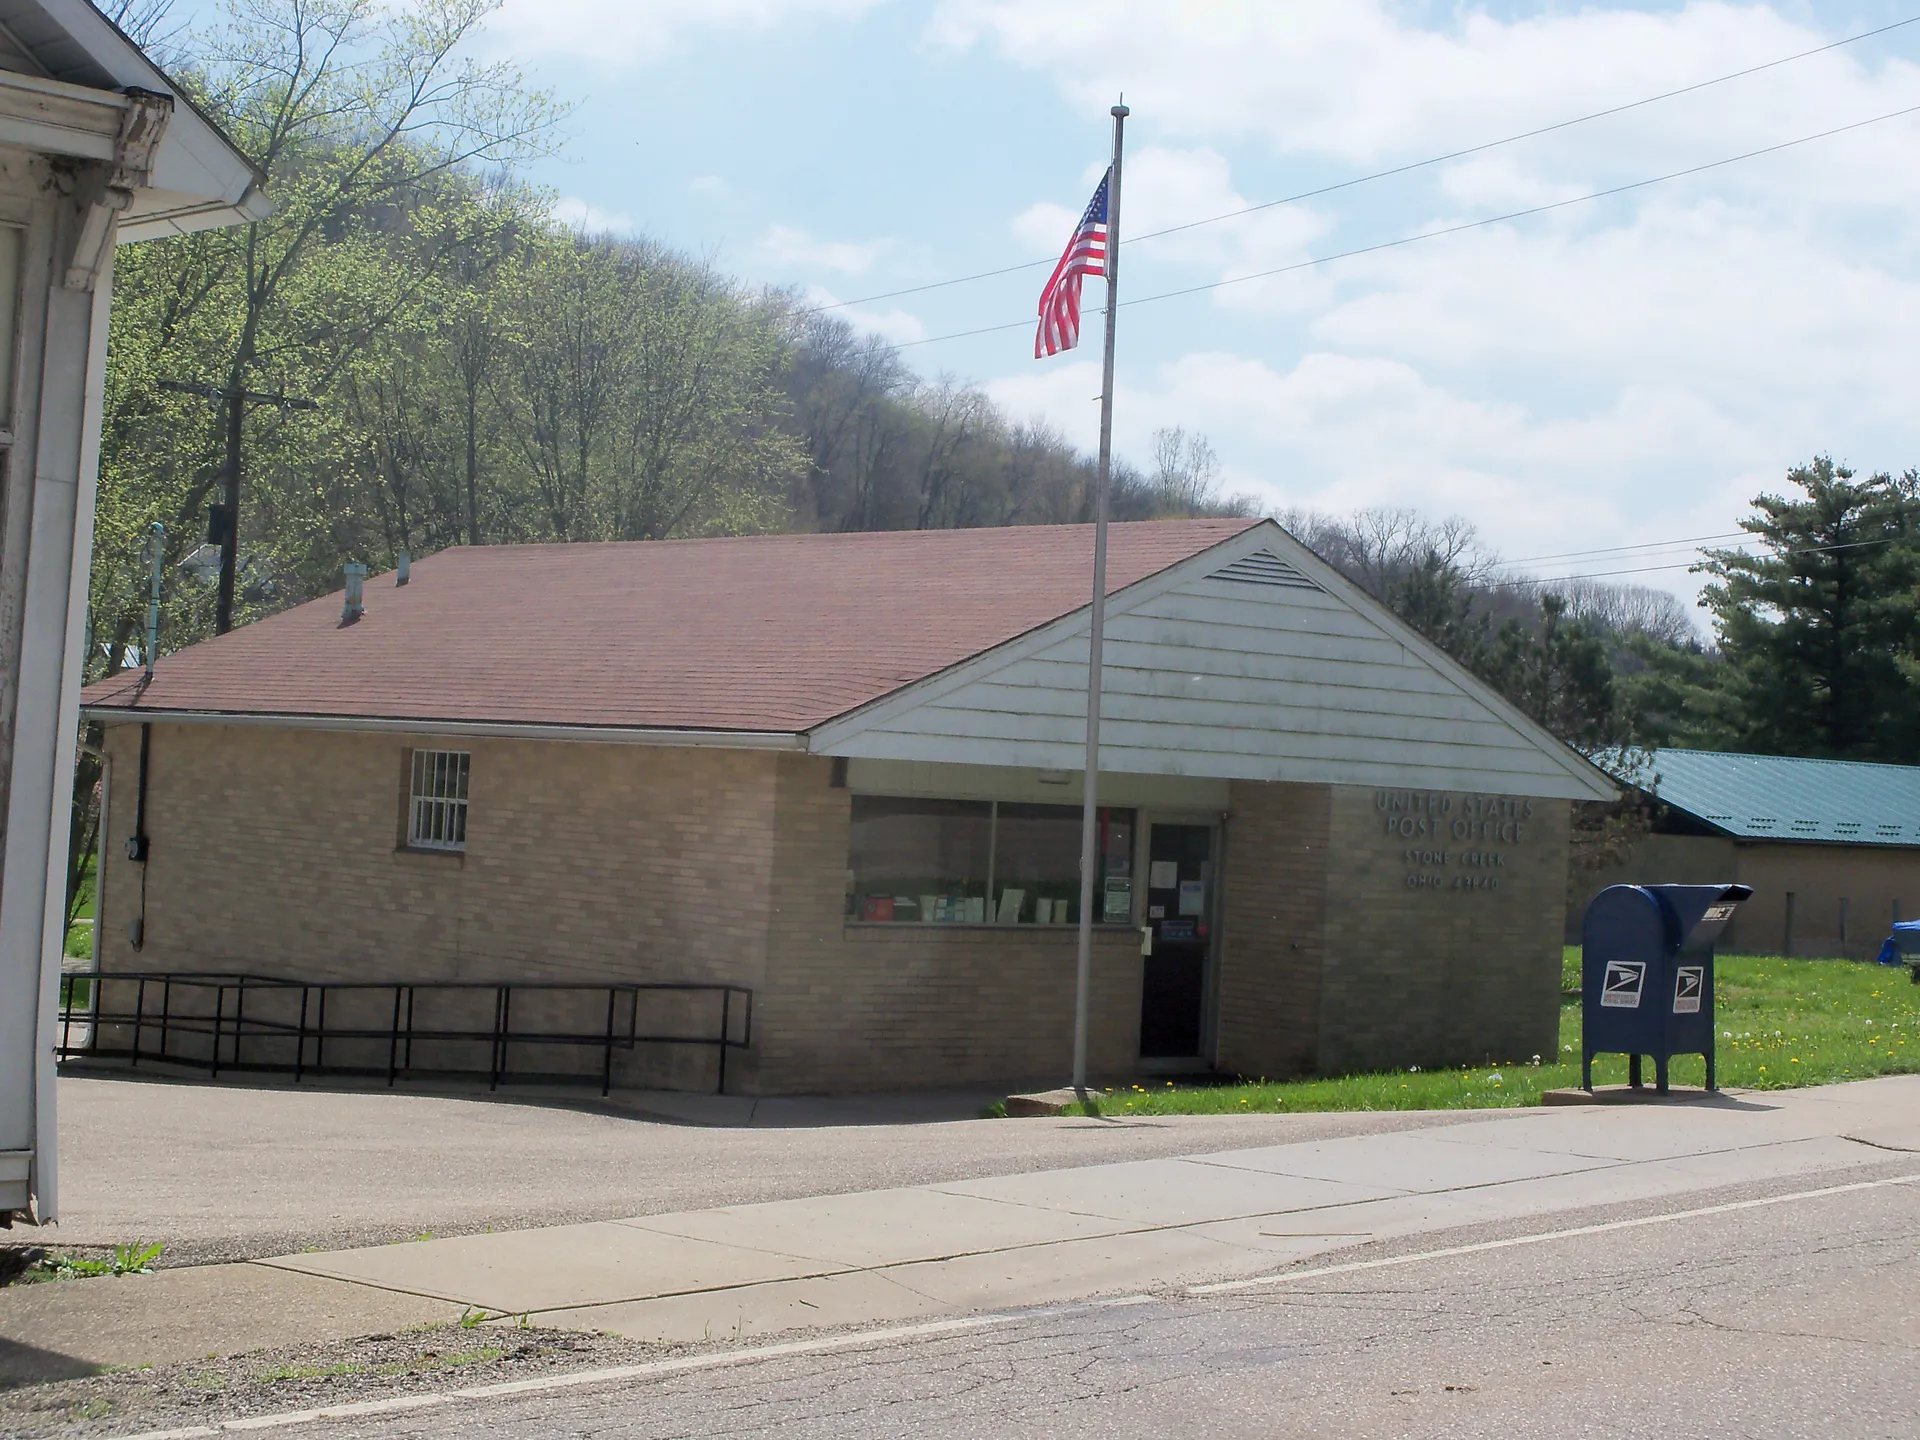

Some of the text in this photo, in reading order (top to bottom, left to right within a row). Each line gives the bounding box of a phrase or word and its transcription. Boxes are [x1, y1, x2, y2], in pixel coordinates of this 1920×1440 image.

[1376, 791, 1534, 820] UNITED STATES
[1387, 817, 1524, 843] POST OFFICE
[1405, 850, 1505, 867] STONE CREEK
[1407, 875, 1442, 889] OHIO
